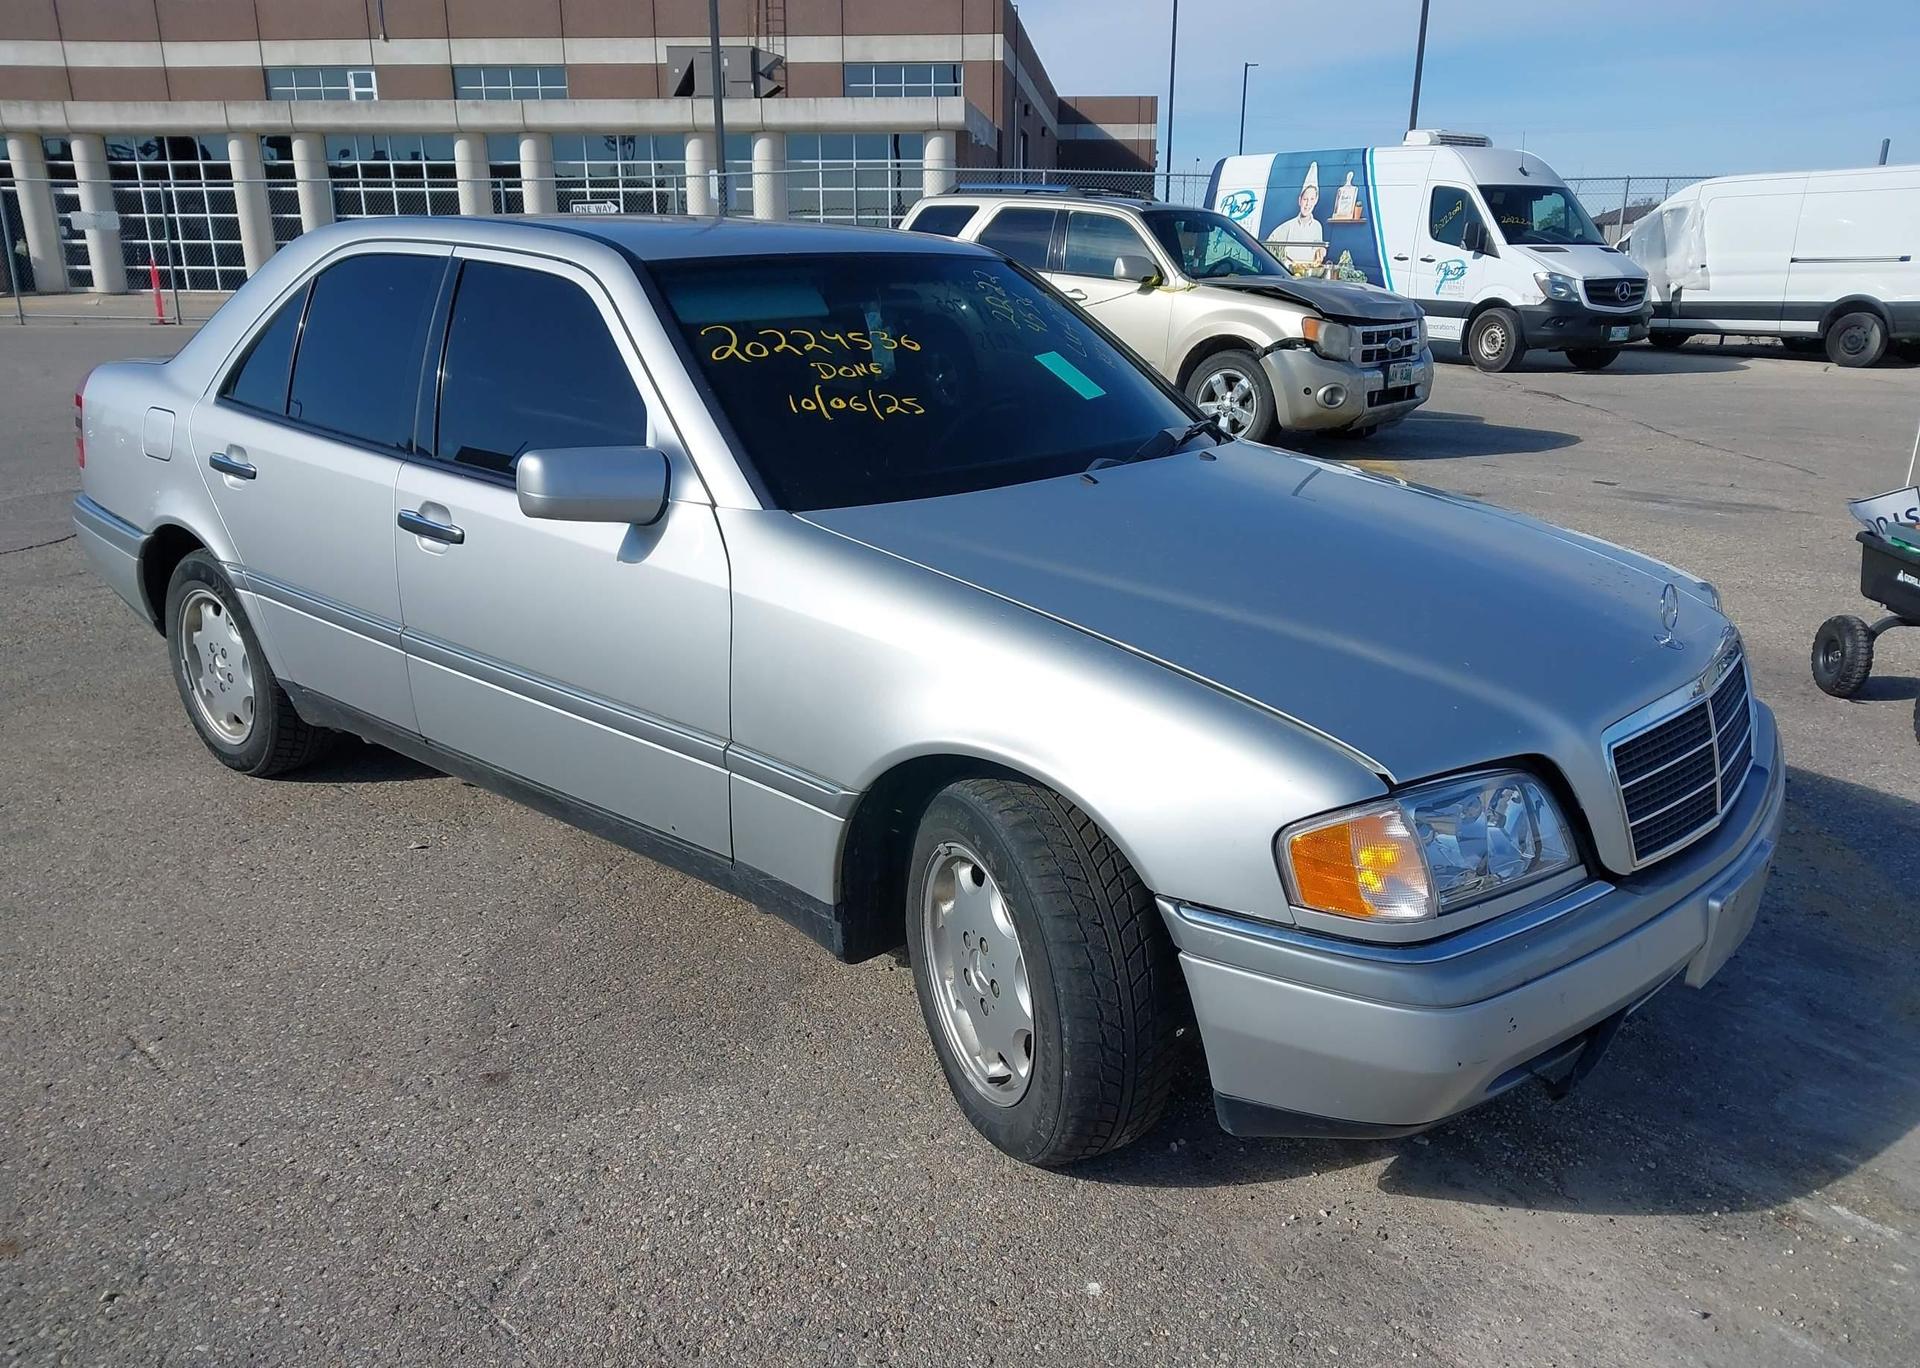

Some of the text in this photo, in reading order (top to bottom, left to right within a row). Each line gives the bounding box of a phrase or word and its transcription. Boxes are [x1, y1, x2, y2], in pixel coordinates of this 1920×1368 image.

[574, 204, 613, 213] ONE WAY
[699, 324, 922, 363] 20224536
[809, 361, 883, 381] DONE
[788, 384, 926, 422] 10/06/25
